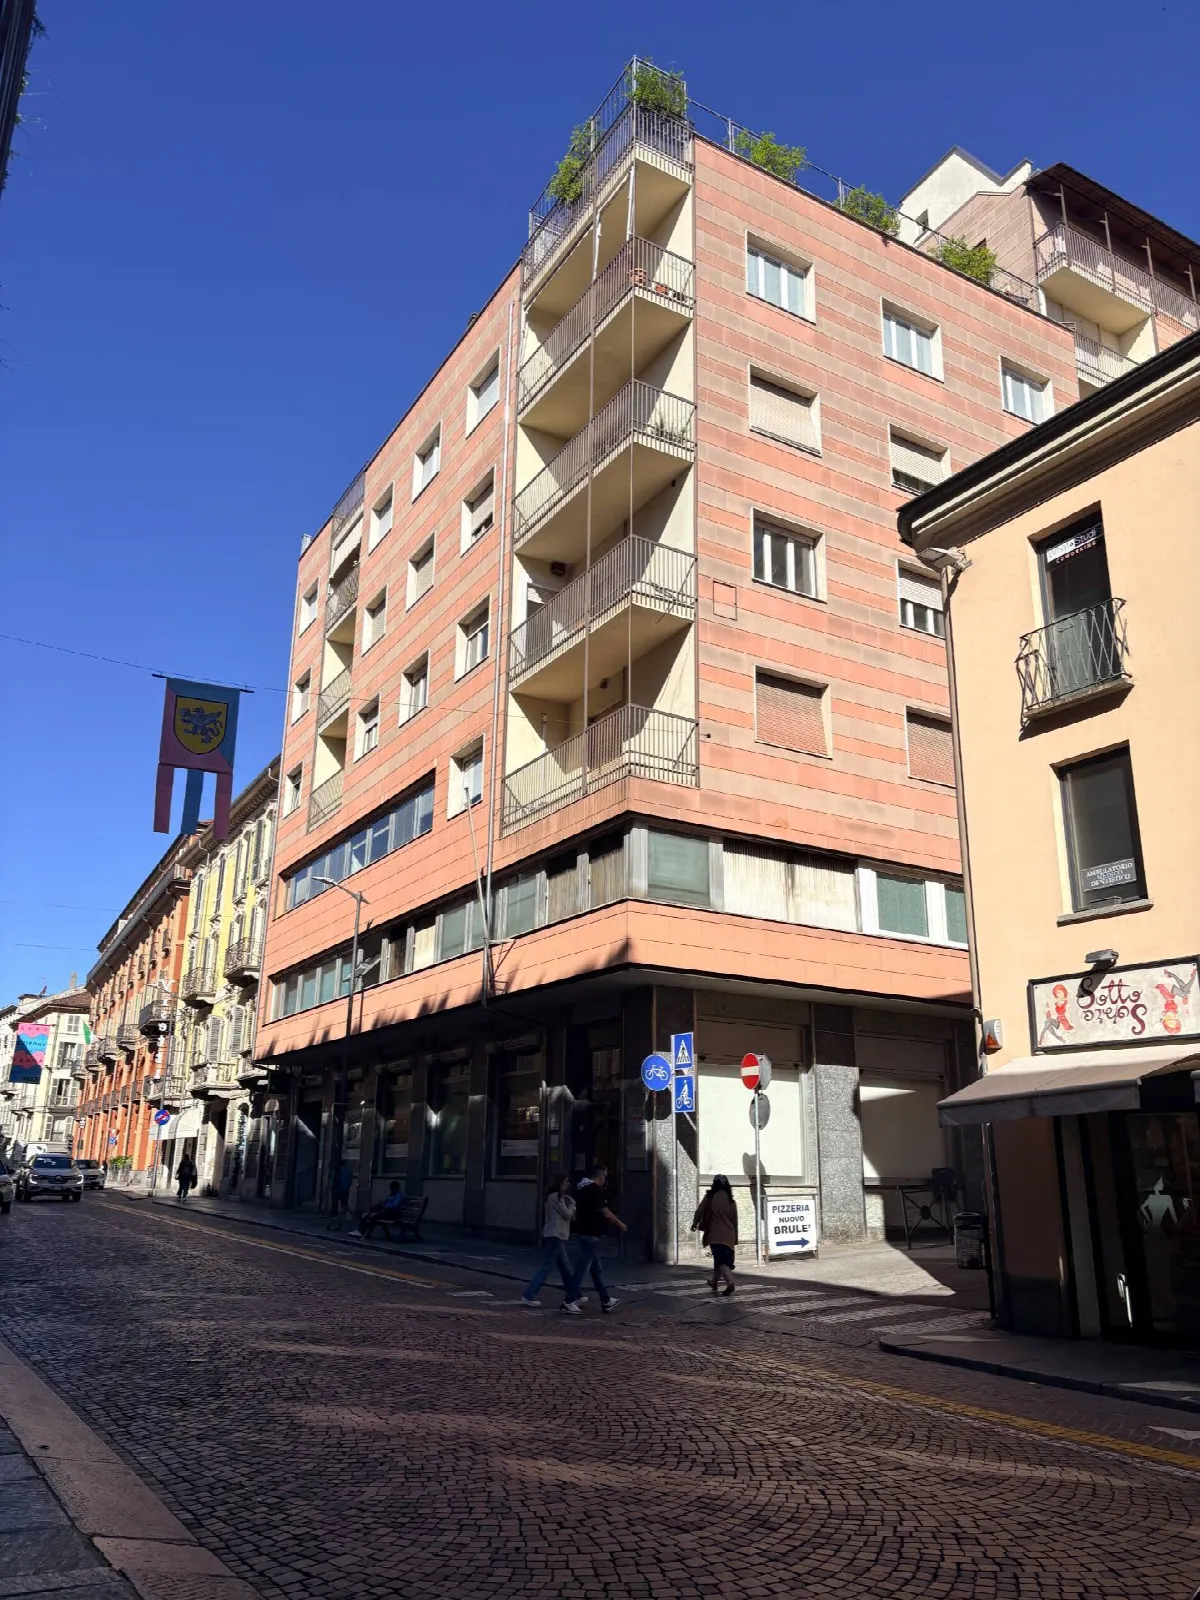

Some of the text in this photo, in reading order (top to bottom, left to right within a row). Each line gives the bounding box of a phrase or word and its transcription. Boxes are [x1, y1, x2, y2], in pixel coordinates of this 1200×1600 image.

[1056, 541, 1096, 563] COWORKING
[1086, 862, 1133, 877] AMBULATORIO
[1096, 870, 1124, 880] MEDICO
[1090, 873, 1131, 887] DENTISTICO
[1077, 977, 1143, 1009] Sotto
[1082, 1003, 1148, 1036] Sopra
[772, 1204, 810, 1213] PIZZERIA
[779, 1215, 805, 1223] NUOVO
[774, 1224, 811, 1235] BRULE'
